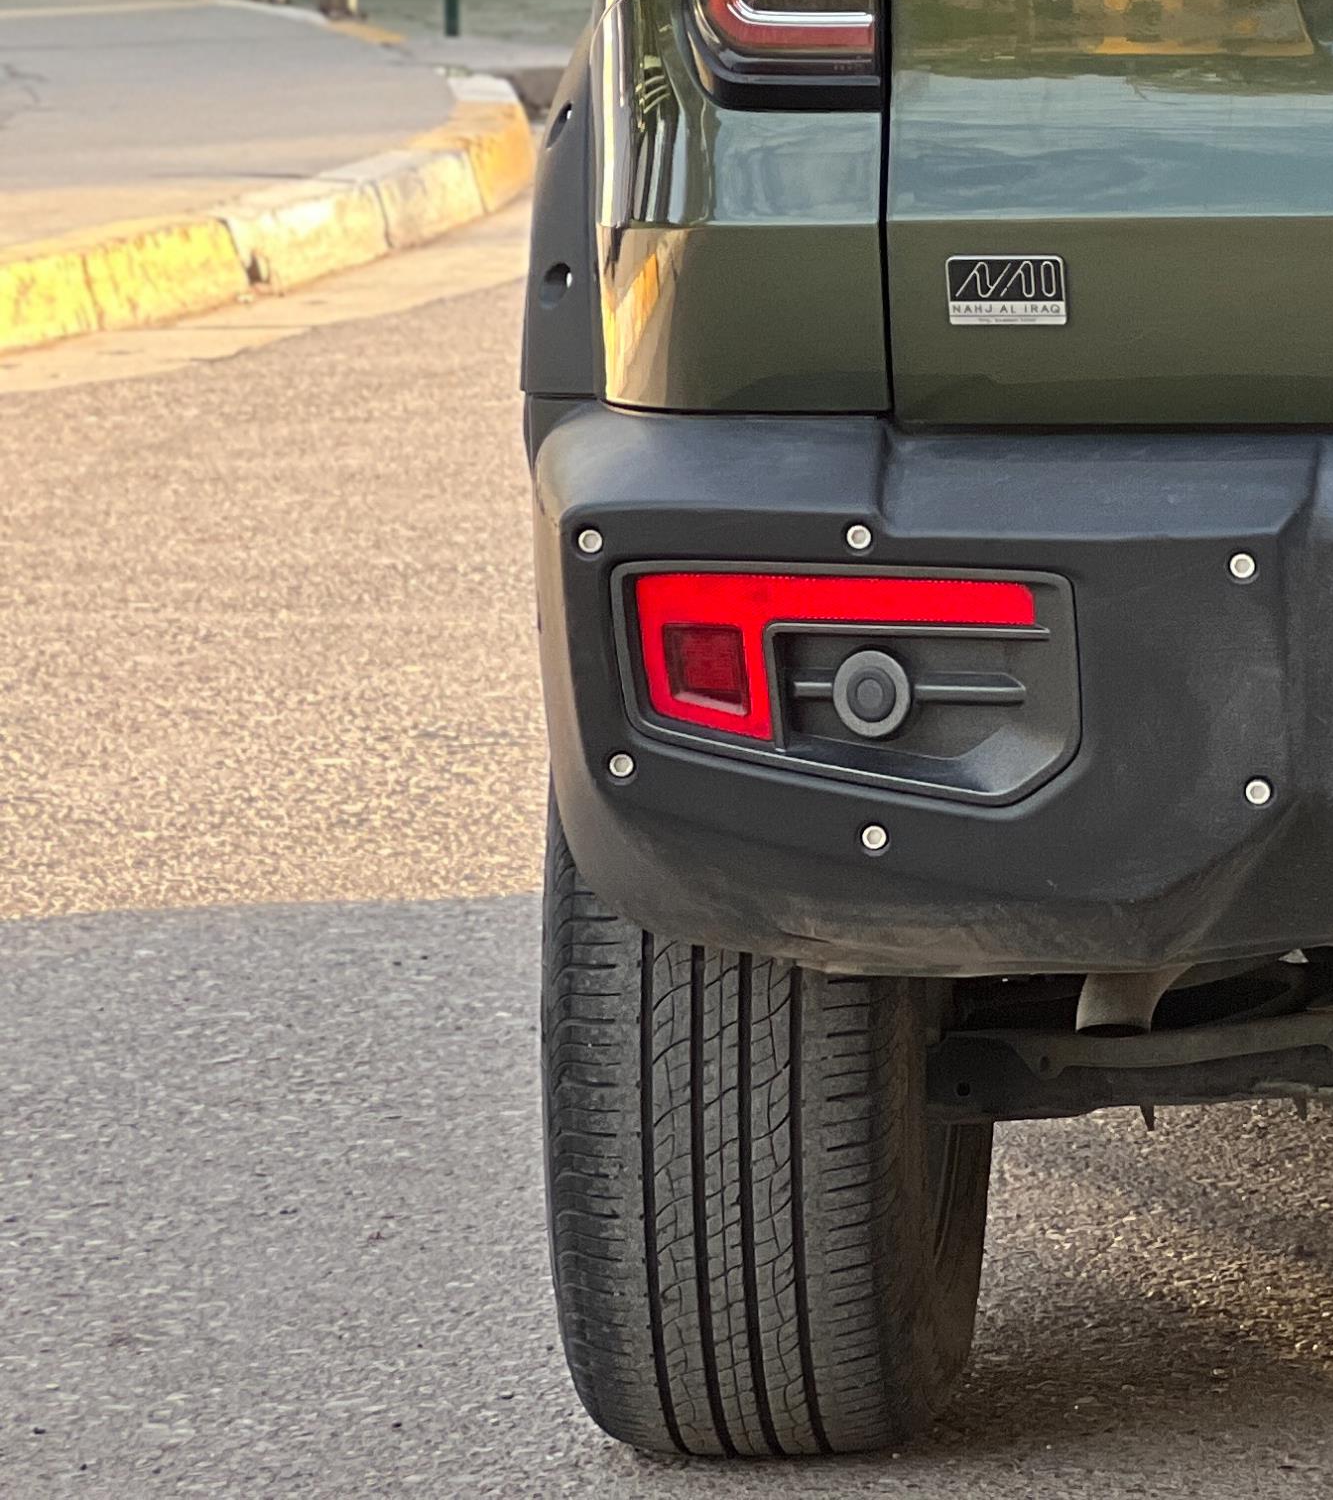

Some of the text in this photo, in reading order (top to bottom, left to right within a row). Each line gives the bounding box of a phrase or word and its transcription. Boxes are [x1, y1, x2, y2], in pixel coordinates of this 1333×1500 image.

[952, 304, 1061, 314] NAHJ AL IRAQ
